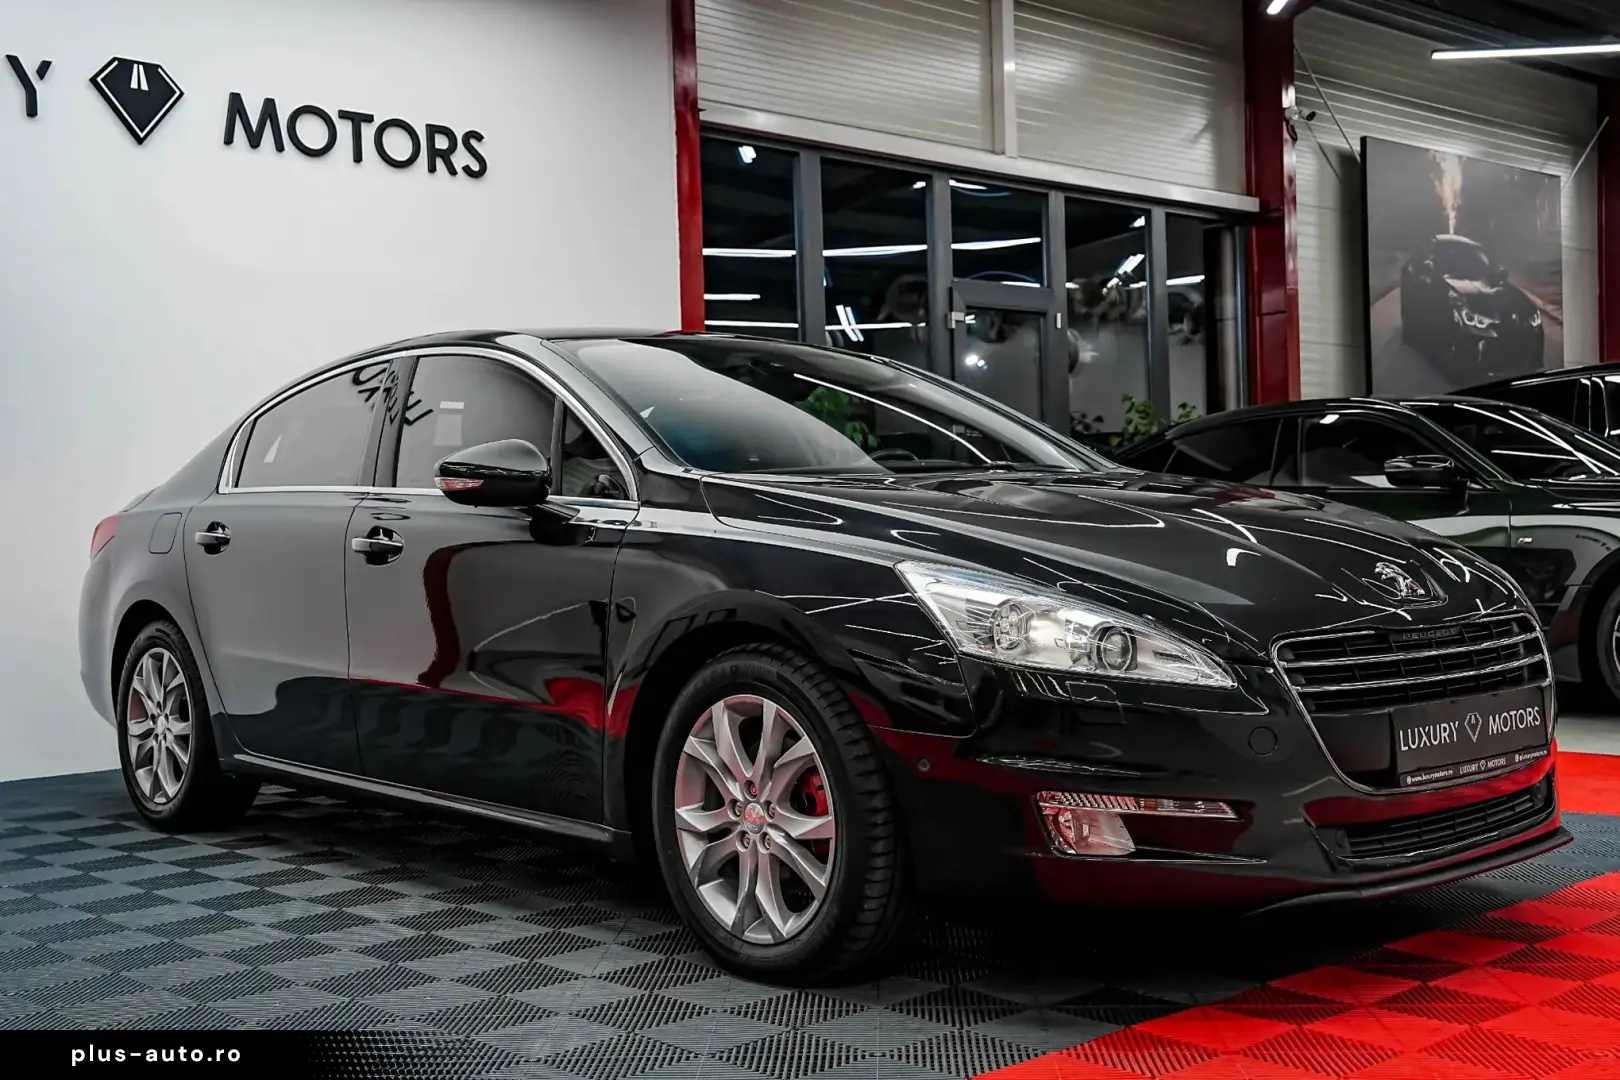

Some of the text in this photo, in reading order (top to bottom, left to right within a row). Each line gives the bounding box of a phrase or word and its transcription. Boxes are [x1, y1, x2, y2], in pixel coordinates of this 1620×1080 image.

[5, 54, 488, 180] Y MOTORS
[1402, 628, 1457, 640] PEUGEOT
[1399, 706, 1541, 751] LUXURY MOTORS
[1459, 757, 1507, 774] LUXURY MOTORS
